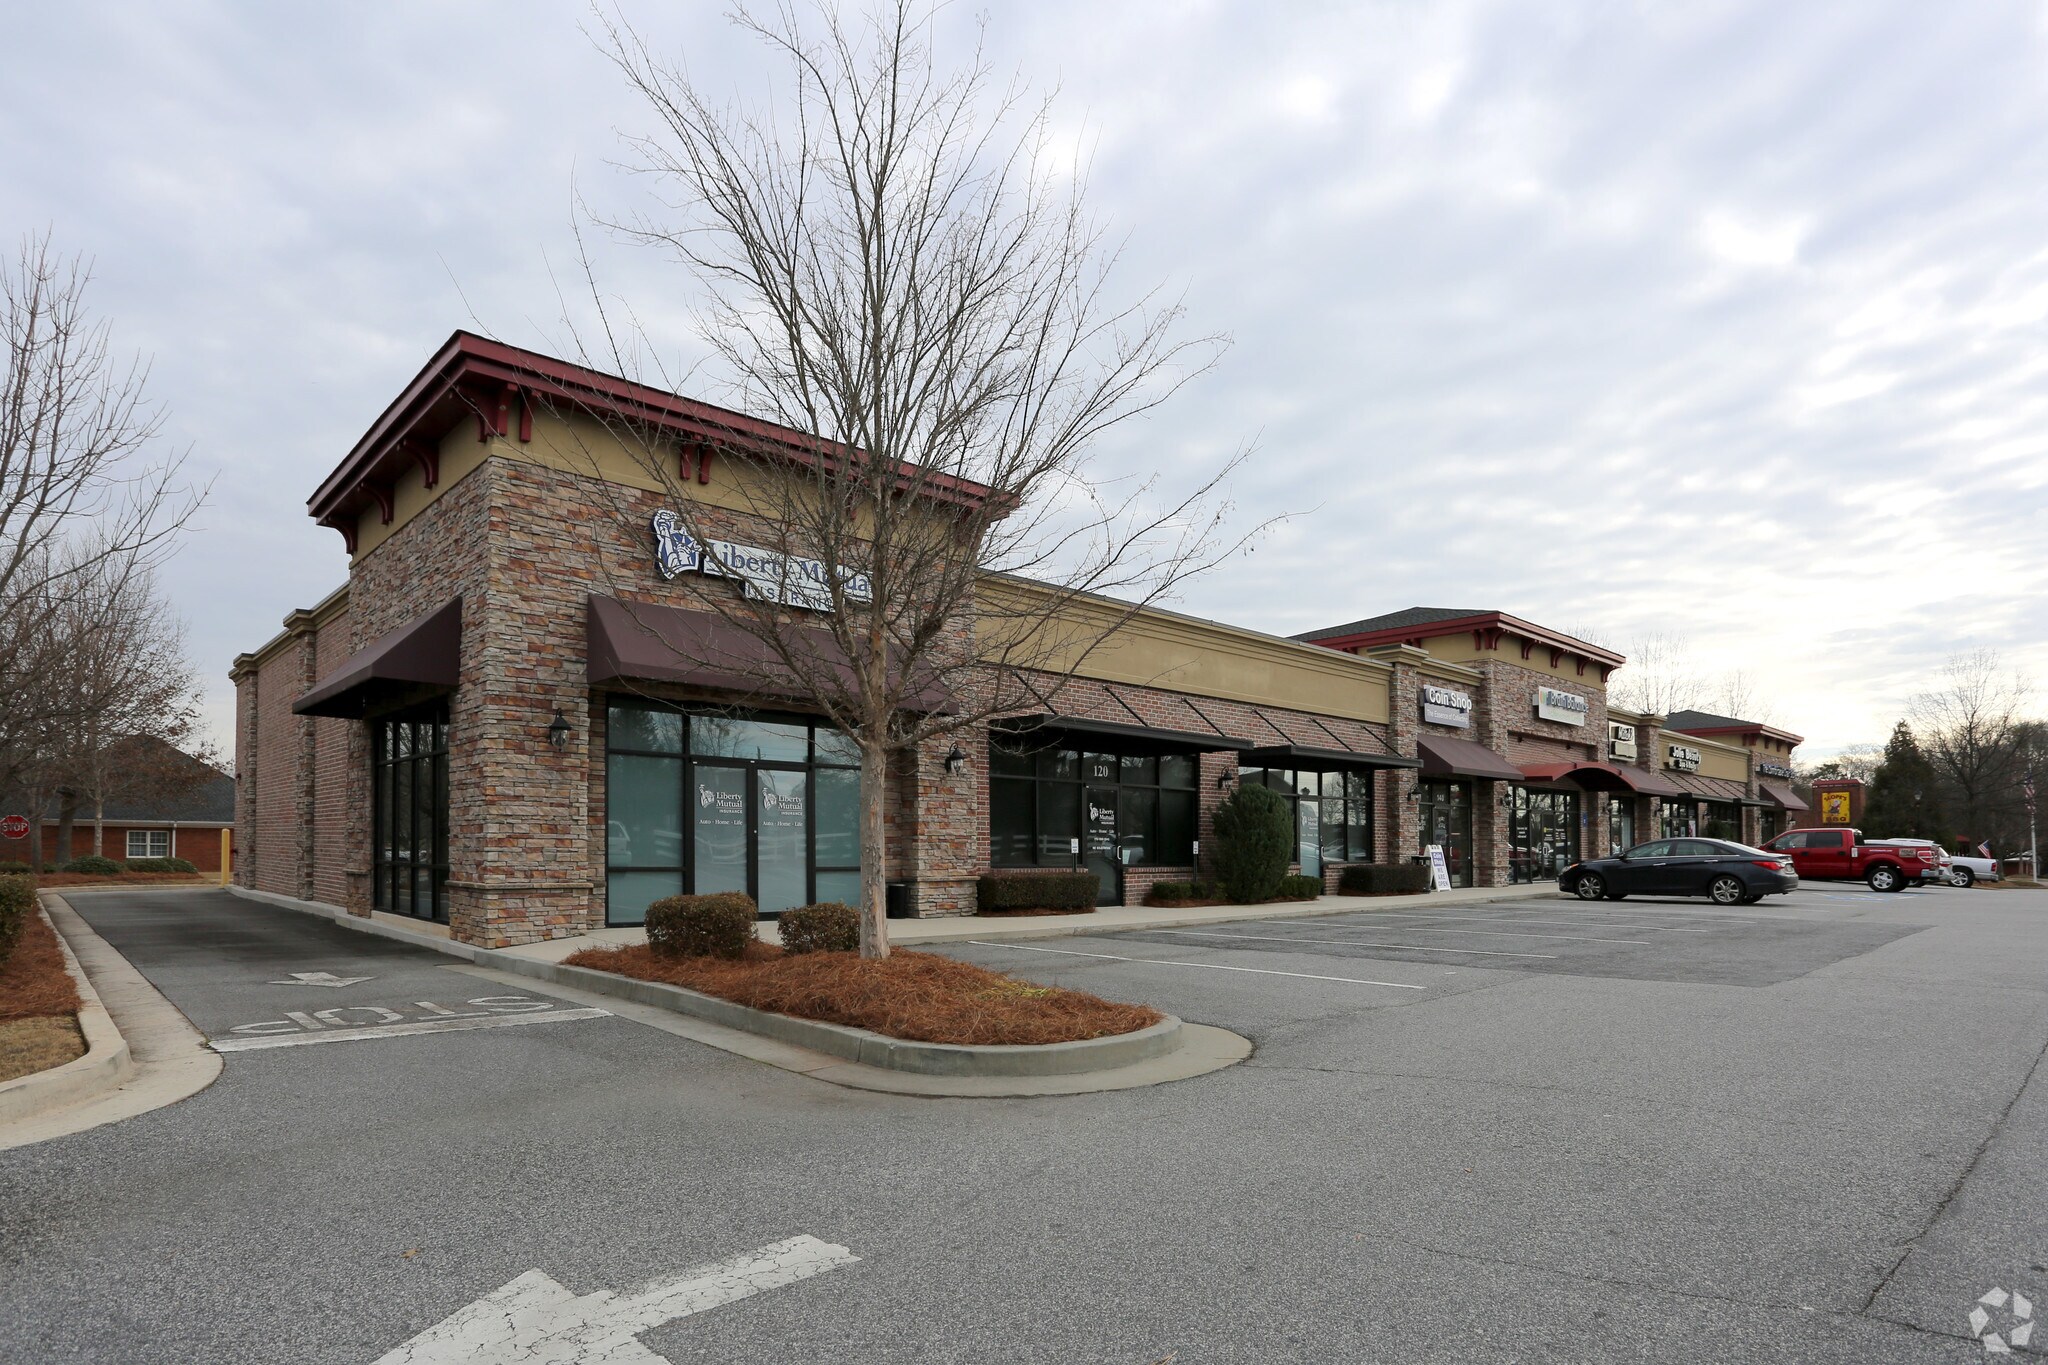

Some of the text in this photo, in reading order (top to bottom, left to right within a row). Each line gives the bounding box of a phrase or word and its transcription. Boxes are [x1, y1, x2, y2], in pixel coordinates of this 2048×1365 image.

[705, 541, 791, 578] ibert
[1429, 688, 1472, 713] Coin Shop
[1093, 765, 1109, 777] 120
[716, 791, 742, 802] Liberty
[778, 794, 802, 804] Liberty
[715, 799, 743, 808] Mutual
[777, 802, 803, 810] Mutual
[2, 822, 28, 832] STOP
[229, 995, 554, 1034] STOP
